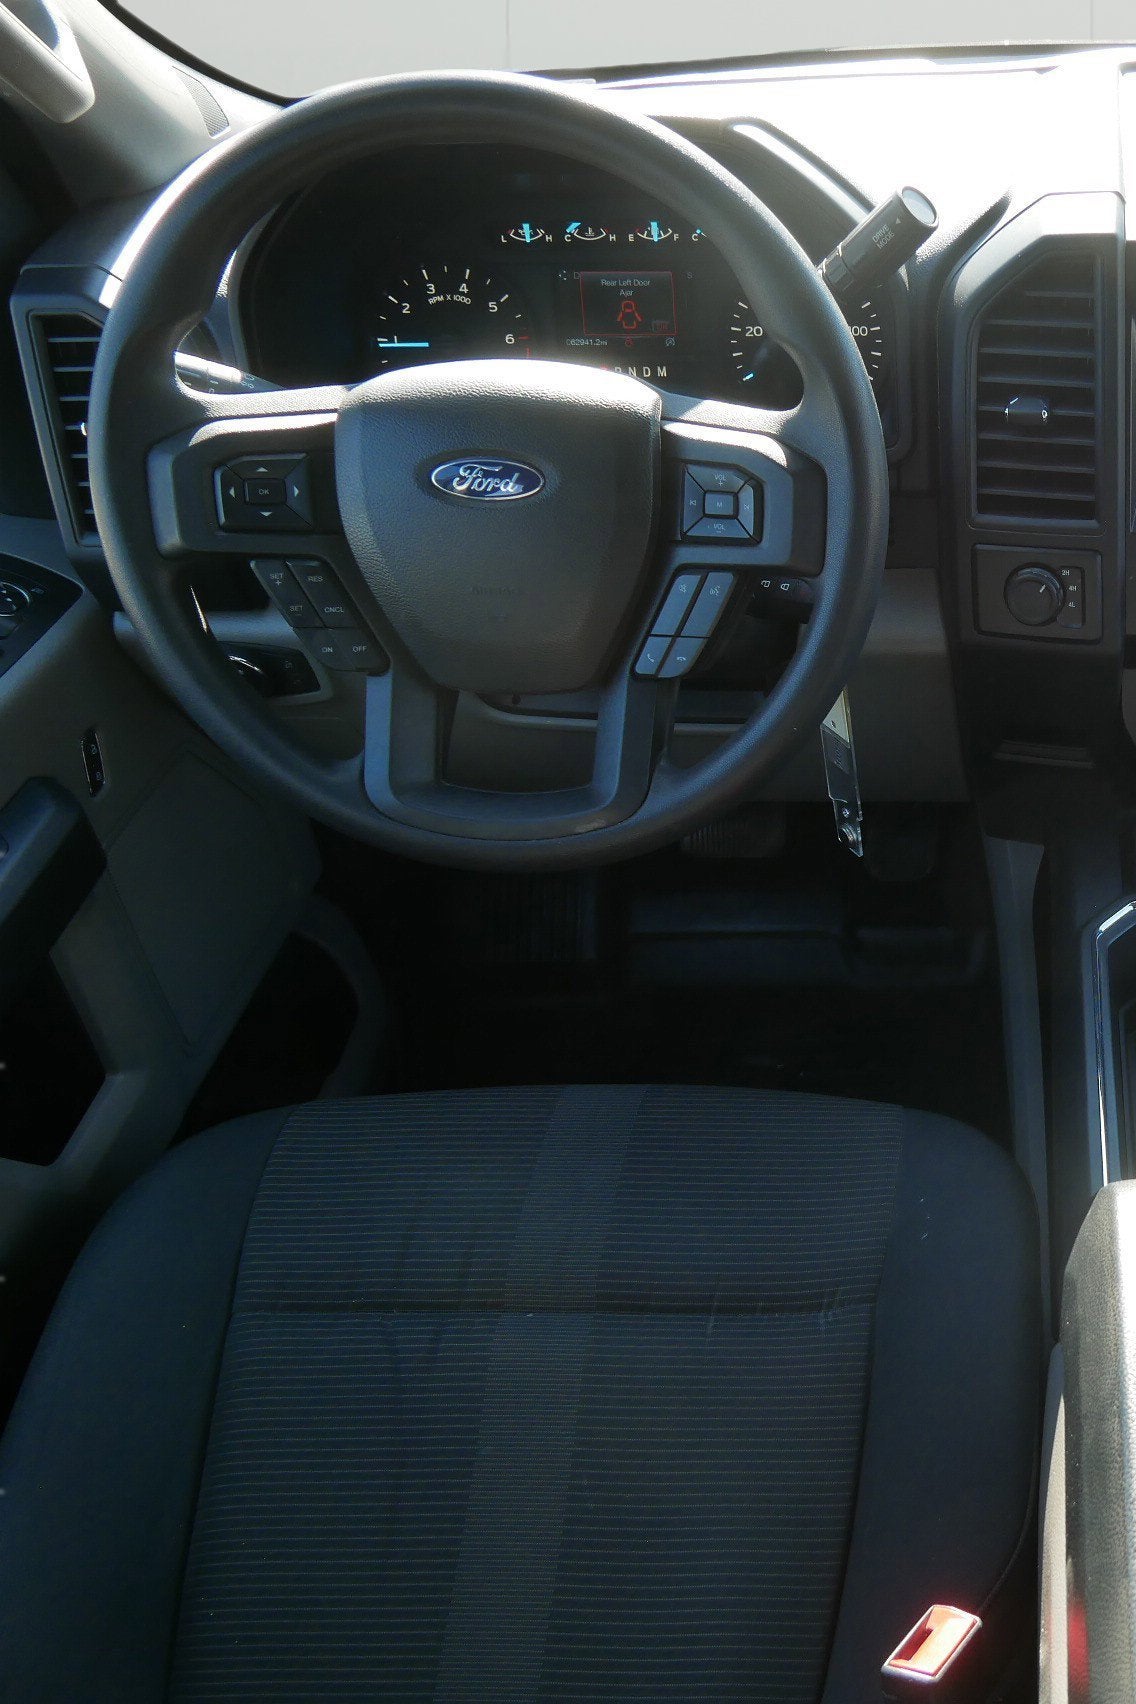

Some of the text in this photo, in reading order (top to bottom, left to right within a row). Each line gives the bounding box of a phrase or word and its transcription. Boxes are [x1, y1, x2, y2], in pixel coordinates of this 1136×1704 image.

[501, 235, 507, 243] L
[545, 234, 553, 242] H
[564, 234, 571, 242] C
[609, 234, 617, 242] H
[628, 234, 635, 242] E
[673, 233, 680, 241] F
[691, 234, 698, 242] C
[872, 224, 890, 243] DRIVE
[876, 231, 895, 249] MODE
[601, 278, 651, 287] Rear Left Door
[426, 283, 436, 295] 3
[458, 283, 469, 294] 4
[619, 289, 634, 298] Ajar
[428, 294, 444, 305] RPM
[401, 303, 411, 314] 2
[488, 301, 498, 313] 5
[745, 326, 763, 337] 20
[505, 333, 515, 345] 6
[628, 367, 637, 377] N
[643, 366, 651, 377] D
[657, 366, 667, 377] M
[452, 463, 524, 493] Ford
[324, 605, 344, 613] CNCL
